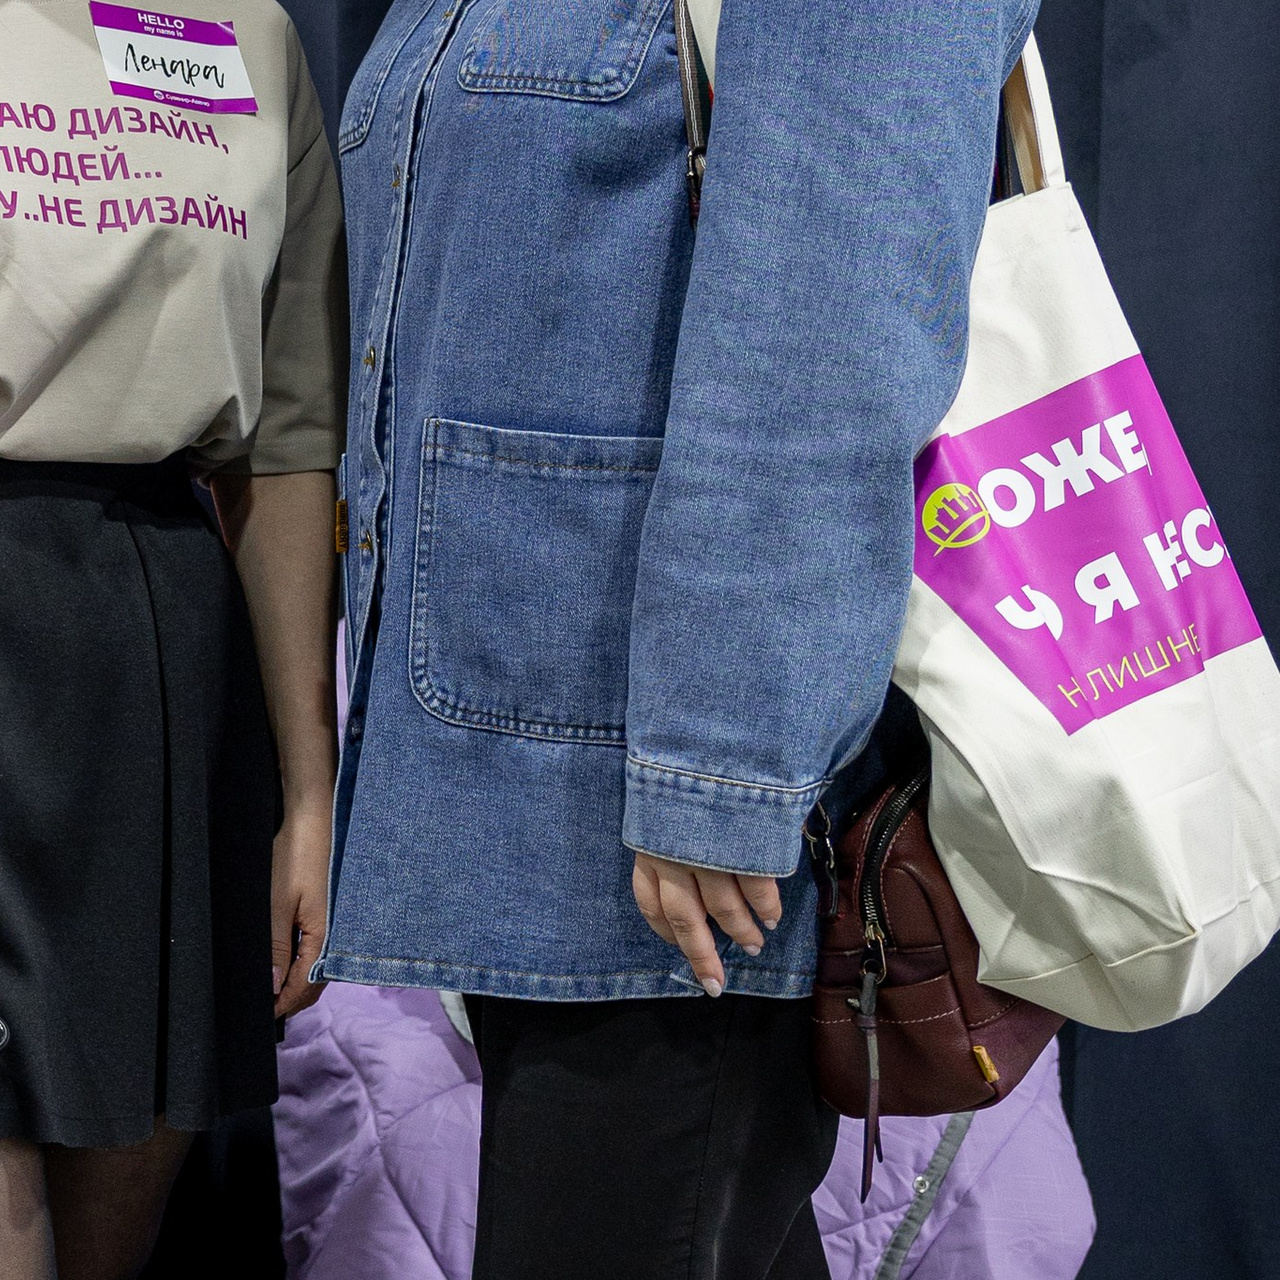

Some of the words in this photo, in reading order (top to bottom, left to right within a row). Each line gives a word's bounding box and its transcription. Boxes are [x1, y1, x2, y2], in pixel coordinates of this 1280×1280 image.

[137, 12, 185, 30] HELLO
[124, 42, 225, 89] Ленара
[68, 106, 231, 155] ДИЗАЙН,
[97, 194, 248, 241] ДИЗАЙН
[976, 409, 1153, 529] ОЖЕ
[1074, 551, 1141, 625] Я
[1086, 623, 1201, 701] ЛИШНЕ
